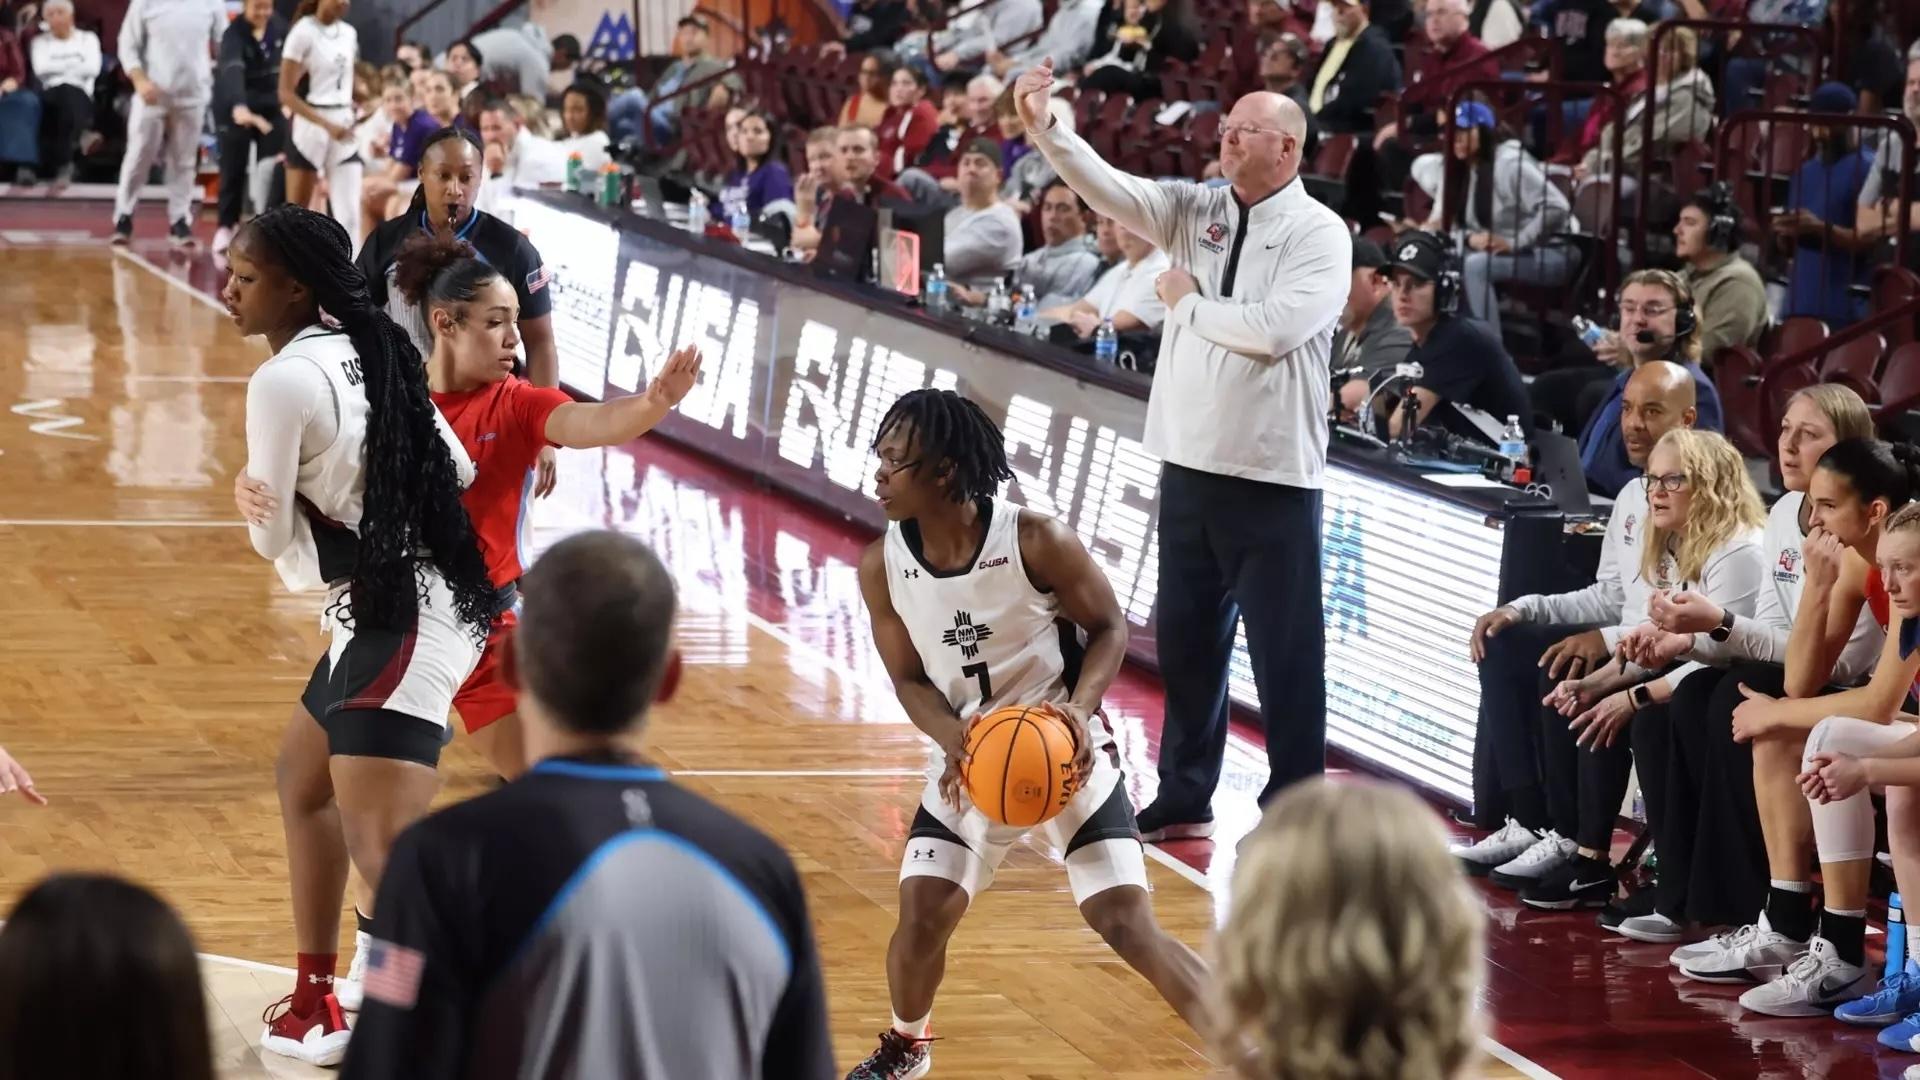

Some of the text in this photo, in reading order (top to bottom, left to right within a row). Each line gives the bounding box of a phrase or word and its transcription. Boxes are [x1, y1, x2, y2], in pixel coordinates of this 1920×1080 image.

[957, 627, 975, 637] NM
[958, 634, 976, 643] STATE
[961, 662, 992, 705] 7
